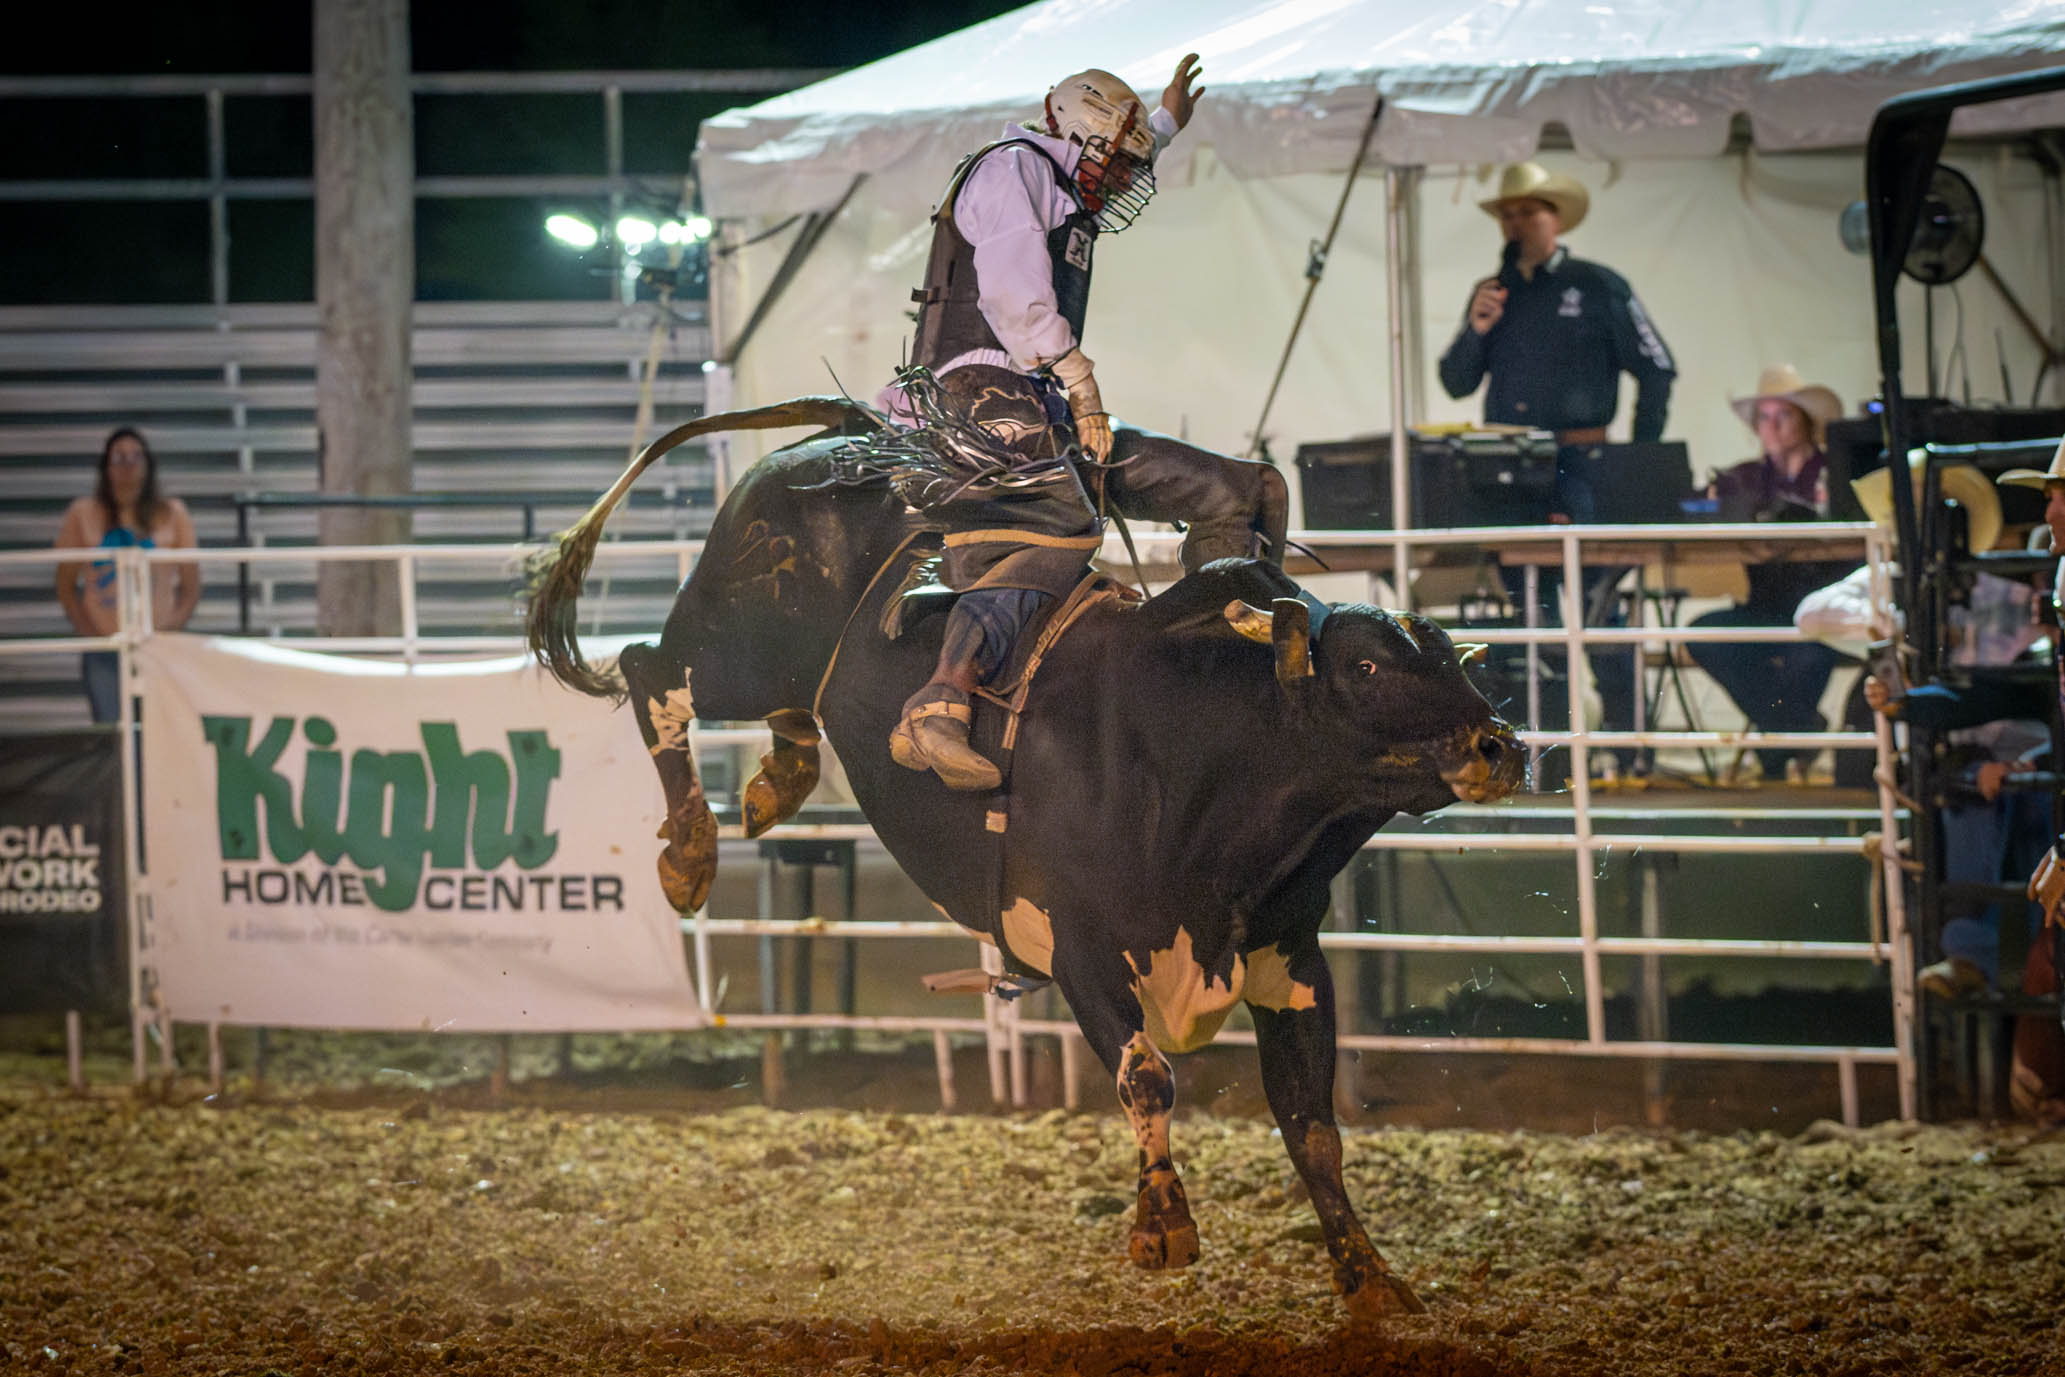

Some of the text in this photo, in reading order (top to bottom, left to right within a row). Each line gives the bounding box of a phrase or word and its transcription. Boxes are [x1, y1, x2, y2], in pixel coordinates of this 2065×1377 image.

[202, 714, 560, 912] Kight
[0, 824, 100, 857] CIAL
[222, 870, 623, 912] HOME CENTER
